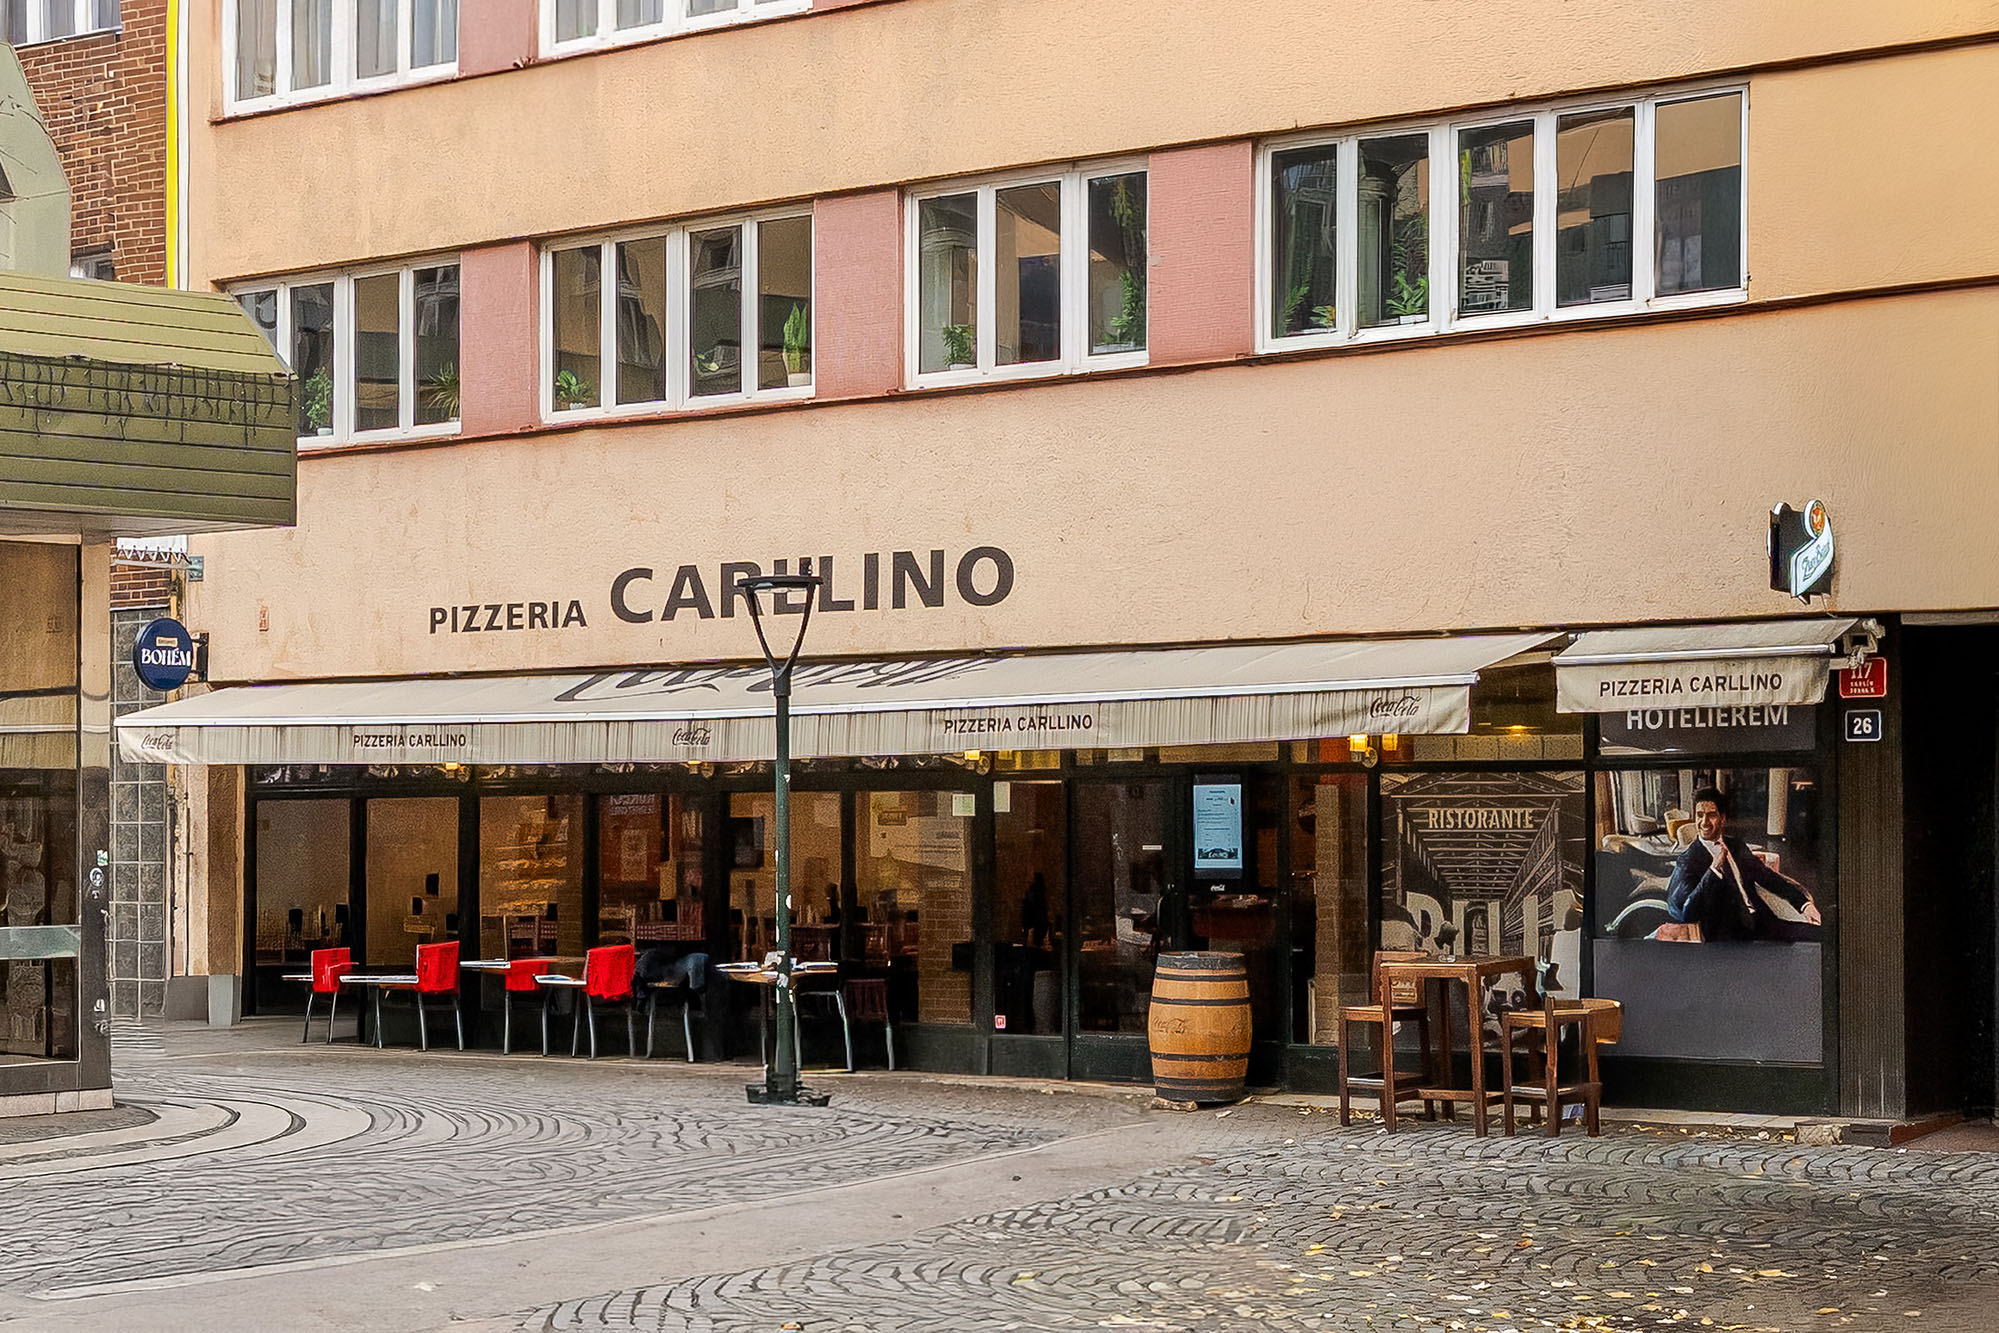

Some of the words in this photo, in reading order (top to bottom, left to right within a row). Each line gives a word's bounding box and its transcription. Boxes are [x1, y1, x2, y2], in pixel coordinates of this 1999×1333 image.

[429, 600, 588, 634] PIZZERIA
[609, 546, 1014, 624] CARLLINO
[1600, 677, 1684, 697] PIZZERIA
[1689, 673, 1782, 693] CARLLINO
[944, 717, 1012, 734] PIZZERIA
[1017, 714, 1093, 731] CARLLINO
[1853, 717, 1873, 735] 26
[353, 734, 405, 748] PIZZERIA
[409, 733, 467, 747] CARLLINO
[1428, 808, 1534, 829] RISTORANTE
